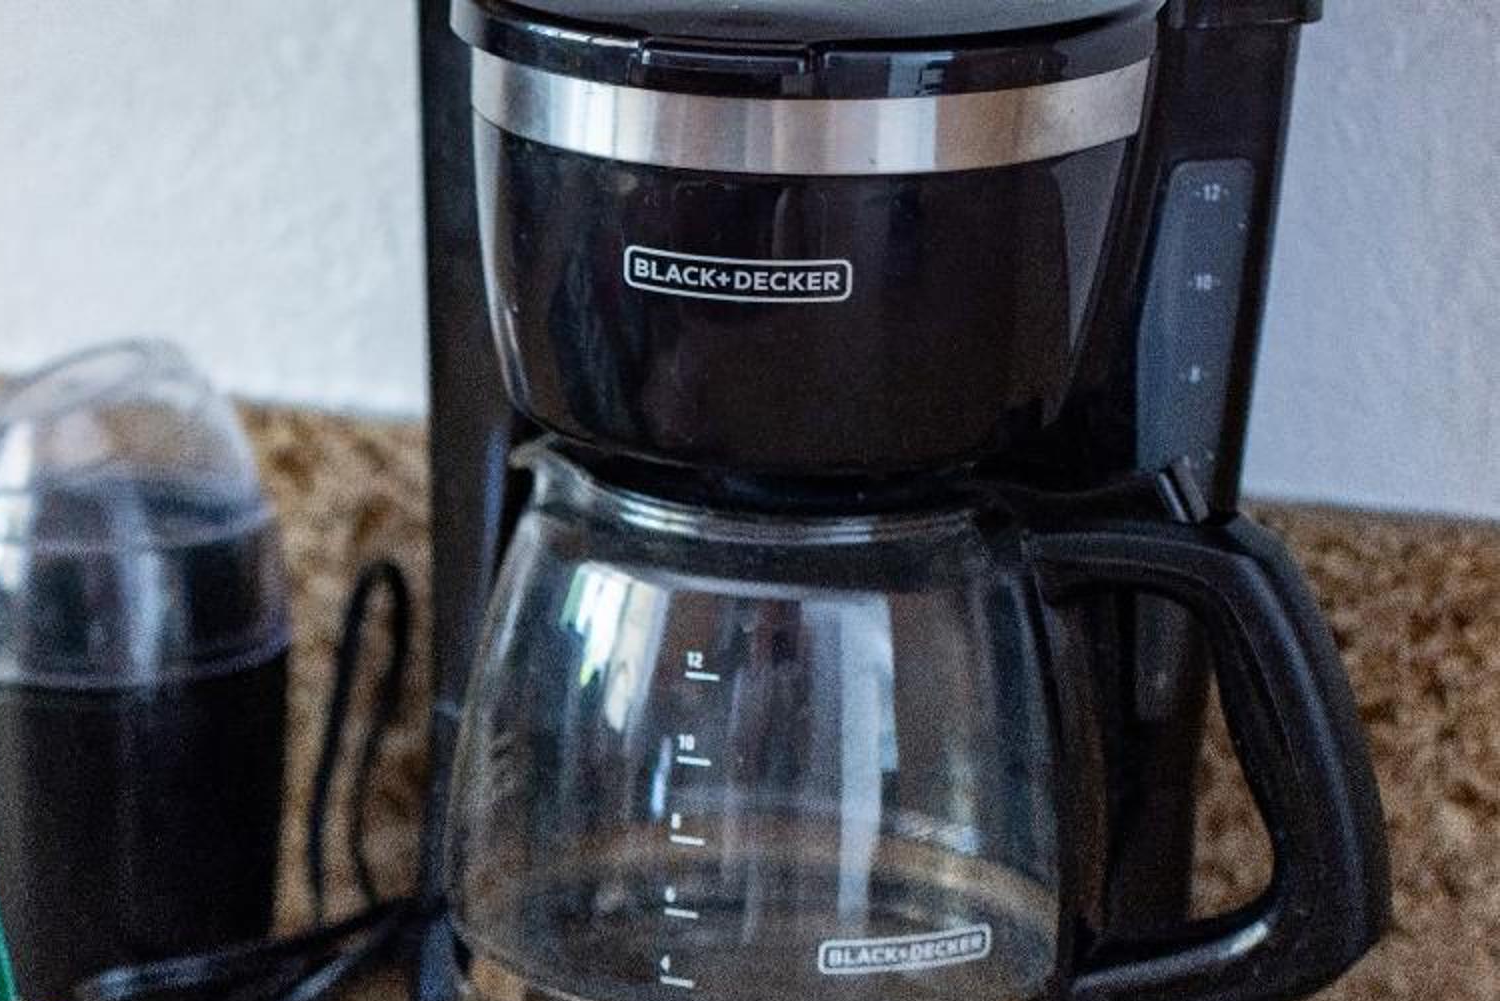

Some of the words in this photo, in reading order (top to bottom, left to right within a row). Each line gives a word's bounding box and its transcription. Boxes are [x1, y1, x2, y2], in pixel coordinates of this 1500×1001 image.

[1203, 183, 1221, 201] 12
[633, 256, 841, 292] BLACK+DECKER
[686, 652, 704, 669] 12
[678, 734, 696, 751] 10
[828, 933, 984, 968] BLACK+DECKER
